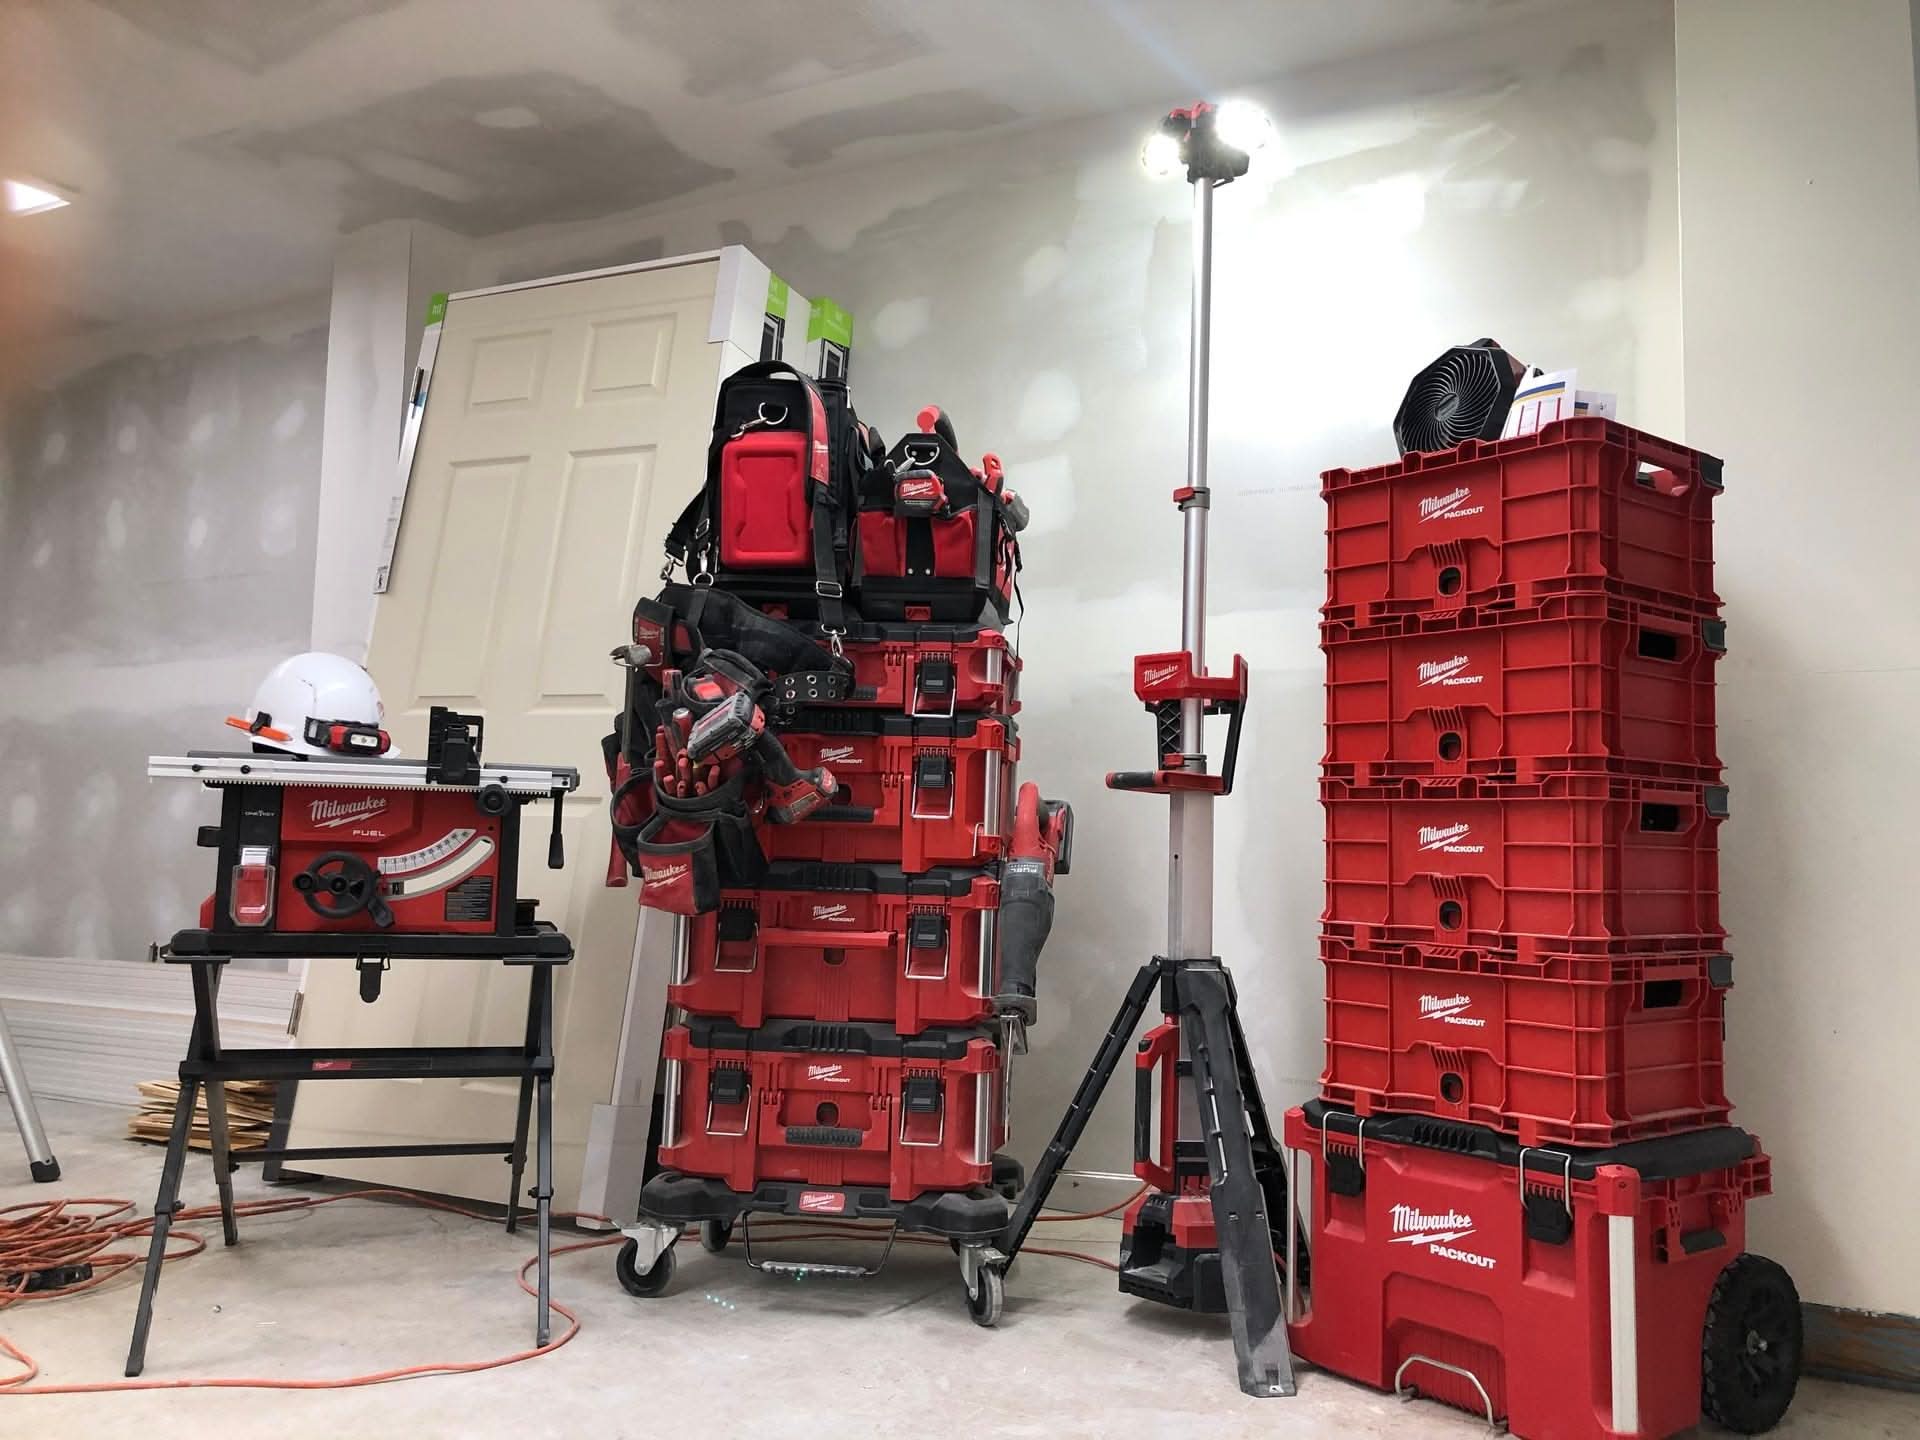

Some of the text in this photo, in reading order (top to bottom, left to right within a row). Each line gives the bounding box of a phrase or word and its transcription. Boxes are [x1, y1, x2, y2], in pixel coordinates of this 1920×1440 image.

[1418, 487, 1471, 517] Milwaukee
[1444, 505, 1485, 519] PACKOUT
[1143, 664, 1179, 684] Milwaukee
[1416, 655, 1470, 681] Milwaukee
[1442, 675, 1484, 686] PACKOUT
[306, 795, 387, 822] Milwaukee
[352, 829, 386, 837] FUEL
[1416, 821, 1470, 845] Milwaukee
[1443, 845, 1485, 853] PACKOUT
[1418, 993, 1472, 1014] Milwaukee
[1444, 1016, 1486, 1027] PACKOUT
[1388, 1202, 1473, 1233] Milwaukee
[1429, 1243, 1497, 1269] PACKOUT
